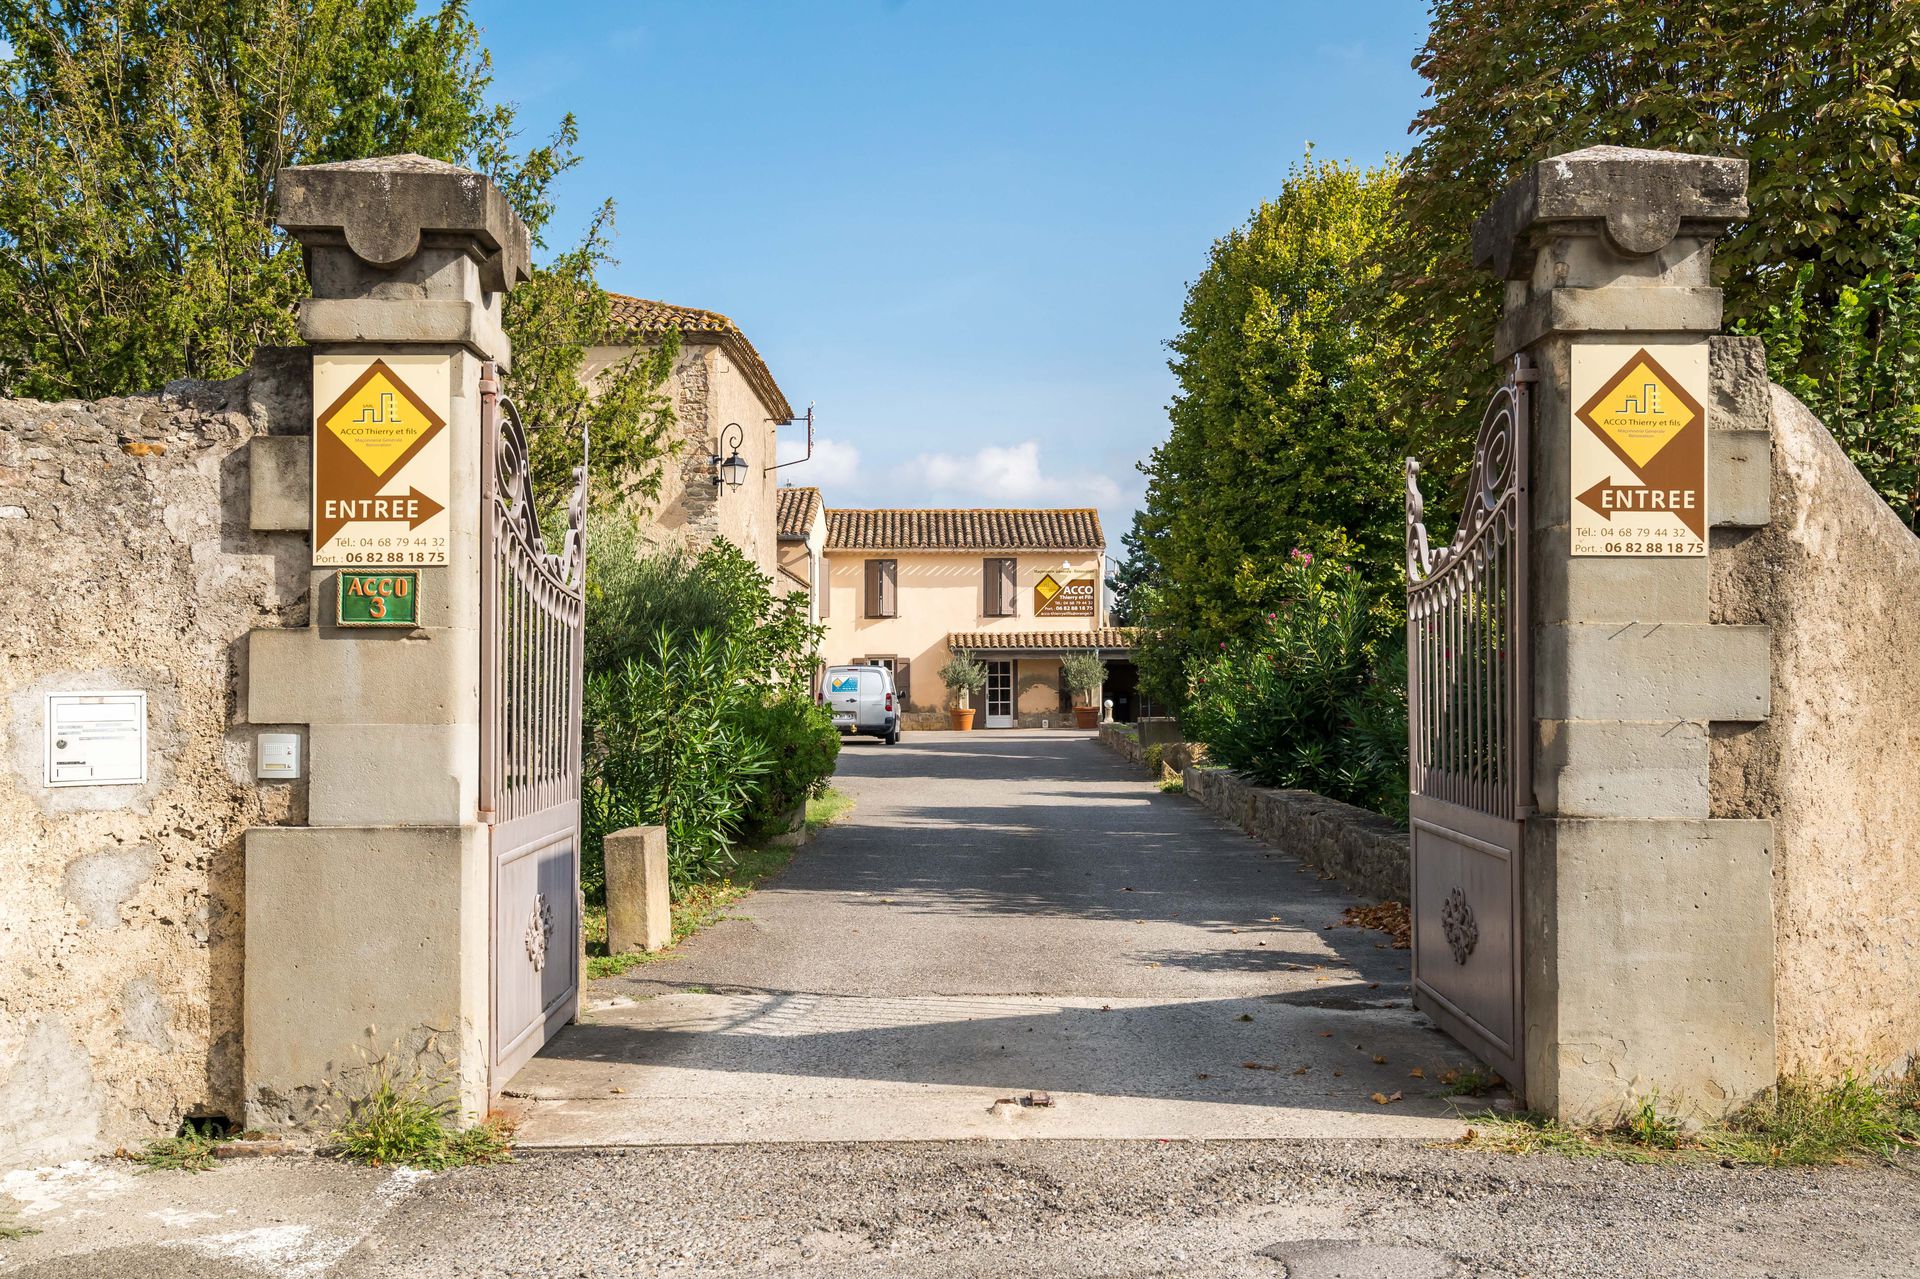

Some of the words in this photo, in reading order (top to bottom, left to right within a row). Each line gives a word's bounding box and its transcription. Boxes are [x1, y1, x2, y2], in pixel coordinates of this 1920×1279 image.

[1629, 418, 1657, 427] Thierry
[365, 428, 393, 436] Thierry
[1601, 490, 1696, 509] ENTREE
[325, 500, 419, 519] ENTREE
[1576, 527, 1596, 536] Tél.:
[1600, 528, 1614, 536] 04
[1618, 528, 1632, 537] 68
[1637, 528, 1650, 537] 79
[1654, 528, 1668, 537] 44
[1673, 528, 1686, 538] 32
[335, 537, 356, 547] Tél.:
[360, 538, 373, 547] 04
[378, 538, 391, 547] 68
[396, 538, 410, 547] 79
[414, 538, 427, 547] 44
[432, 538, 445, 546] 32
[1605, 542, 1622, 552] 06
[1626, 542, 1642, 552] 82
[1646, 542, 1663, 552] 88
[1668, 543, 1683, 553] 18
[1687, 543, 1704, 553] 75
[346, 552, 363, 562] 06
[366, 552, 383, 562] 82
[387, 552, 404, 562] 88
[408, 552, 424, 562] 18
[428, 552, 445, 562] 75
[348, 578, 408, 597] ACCO
[1063, 586, 1093, 594] ACCO
[370, 596, 386, 618] 3
